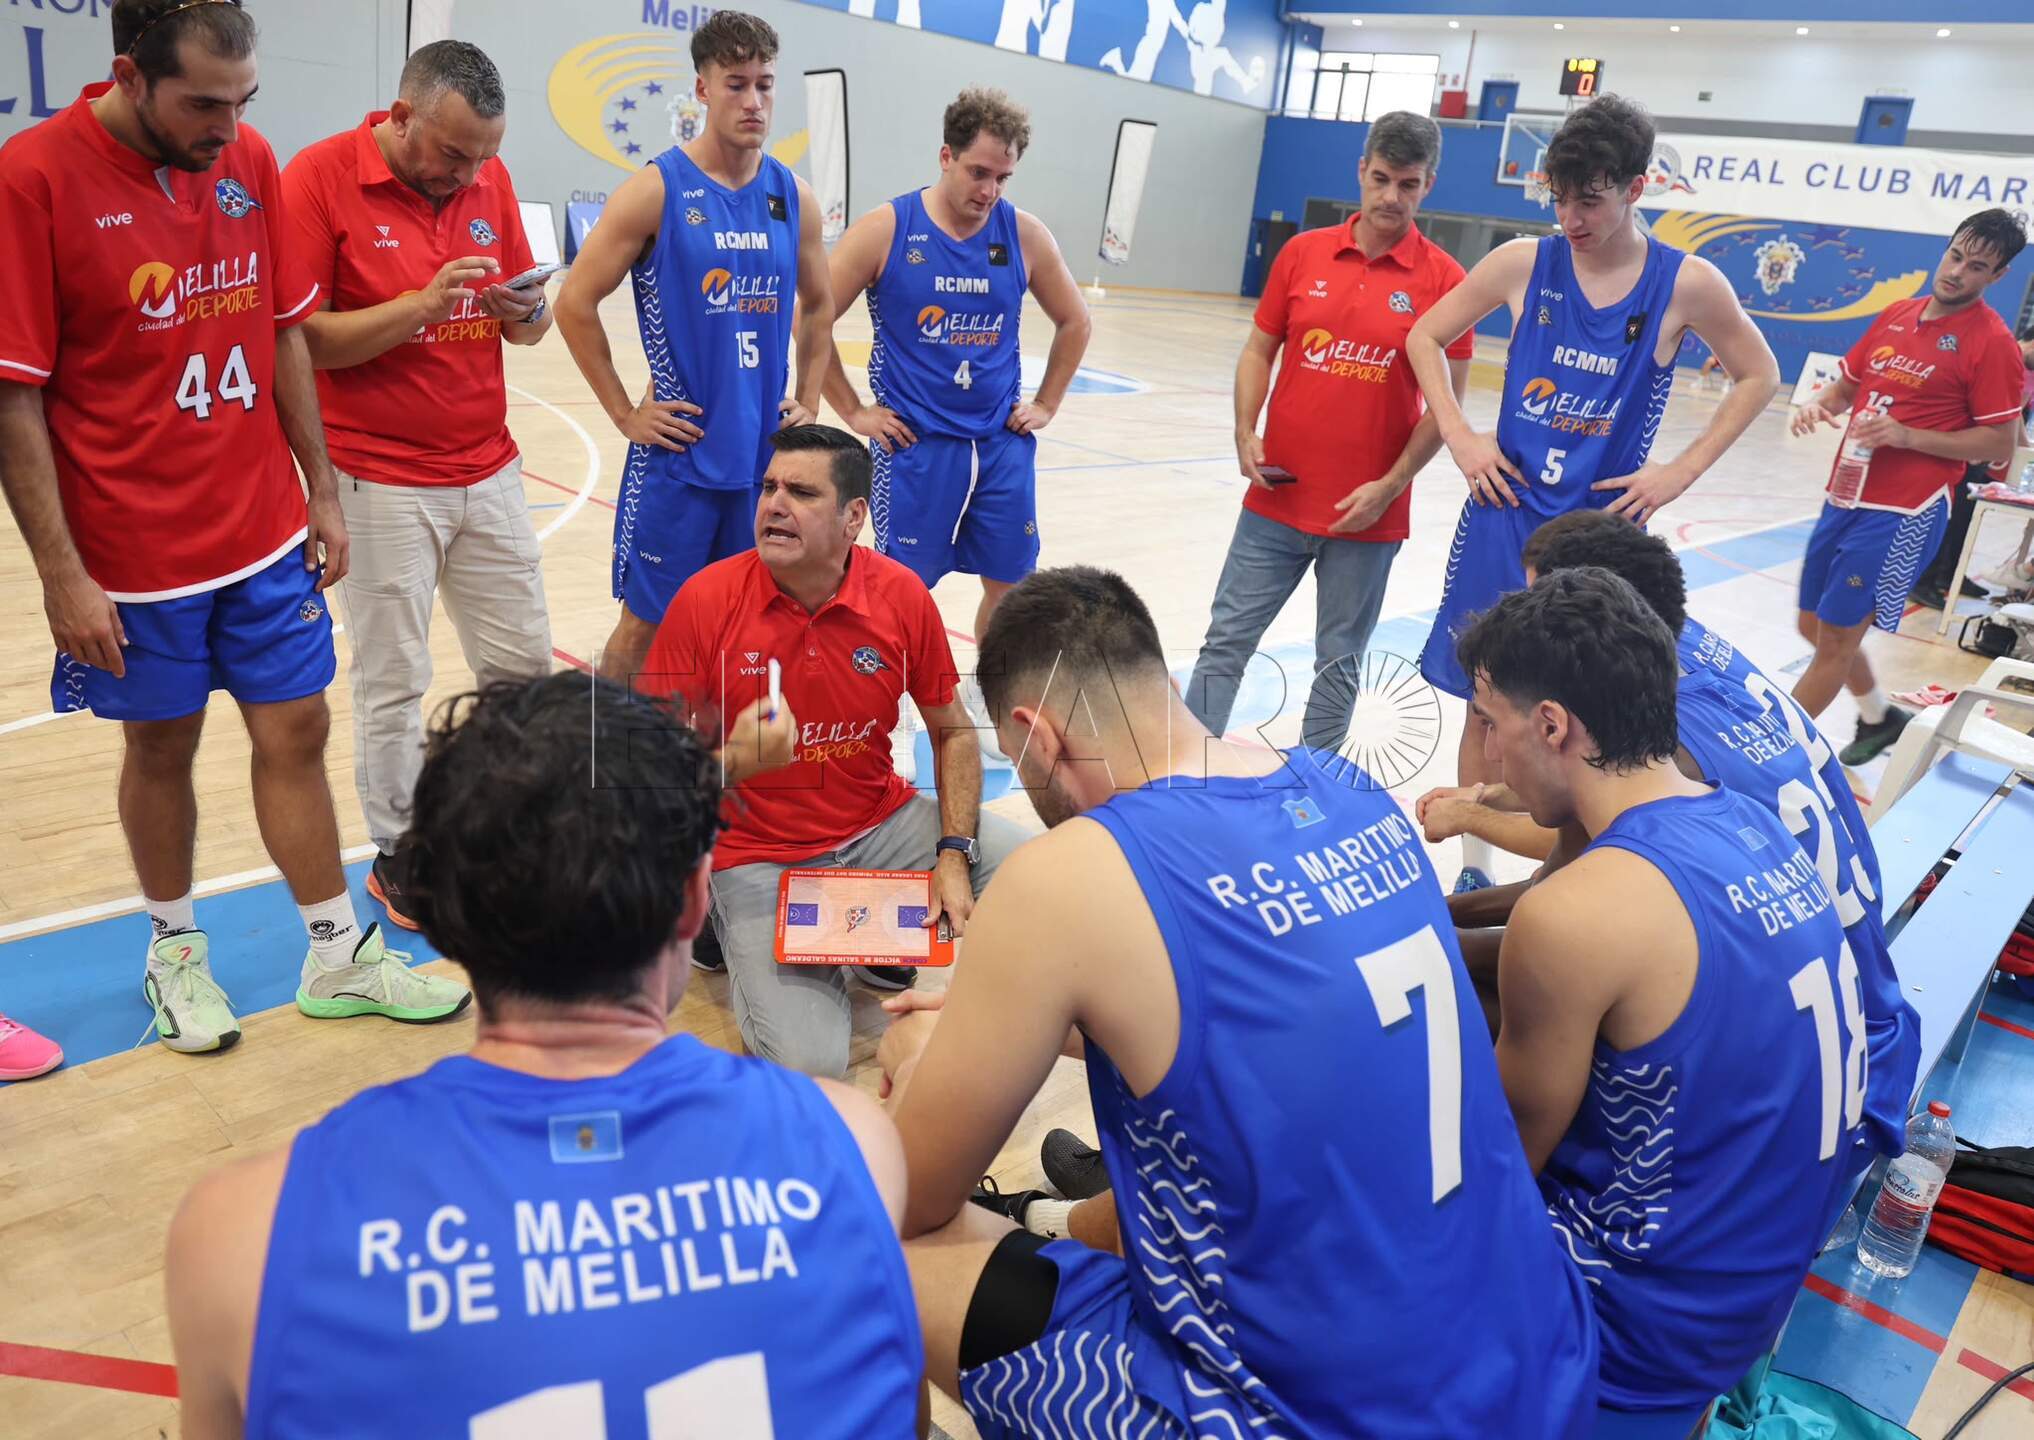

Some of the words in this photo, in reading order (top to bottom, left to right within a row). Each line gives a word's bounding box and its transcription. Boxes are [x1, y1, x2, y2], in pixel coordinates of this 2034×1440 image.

[683, 188, 705, 199] vive
[1693, 156, 1785, 186] REAL
[1805, 163, 1911, 194] CLUB
[1931, 172, 2034, 204] MAR
[96, 212, 133, 229] vive
[373, 239, 400, 248] vive
[713, 231, 768, 250] RCMM
[907, 234, 928, 242] vive
[935, 276, 989, 294] RCMM
[1540, 287, 1563, 302] vive
[138, 317, 174, 332] ciudad
[186, 287, 262, 321] DEPORTE
[736, 331, 760, 369] 15
[949, 332, 1000, 346] DEPORTE
[1330, 361, 1389, 384] DEPORTE
[1552, 345, 1619, 376] RCMM
[175, 344, 258, 420] 44
[954, 360, 973, 391] 4
[1551, 415, 1613, 437] DEPORTE
[1540, 448, 1567, 485] 5
[898, 536, 918, 545] vive
[638, 549, 662, 564] vive
[740, 666, 767, 675] vive
[795, 718, 877, 746] ELILLA
[1206, 861, 1300, 909] R.C.
[1725, 875, 1774, 914] R.C.
[1256, 890, 1323, 938] DE
[1757, 901, 1793, 937] DE
[1354, 923, 1463, 1204] 7
[358, 1205, 490, 1277] R.C.
[514, 1177, 821, 1256] MARITIMO
[407, 1262, 499, 1333] DE
[523, 1226, 798, 1316] MELILLA
